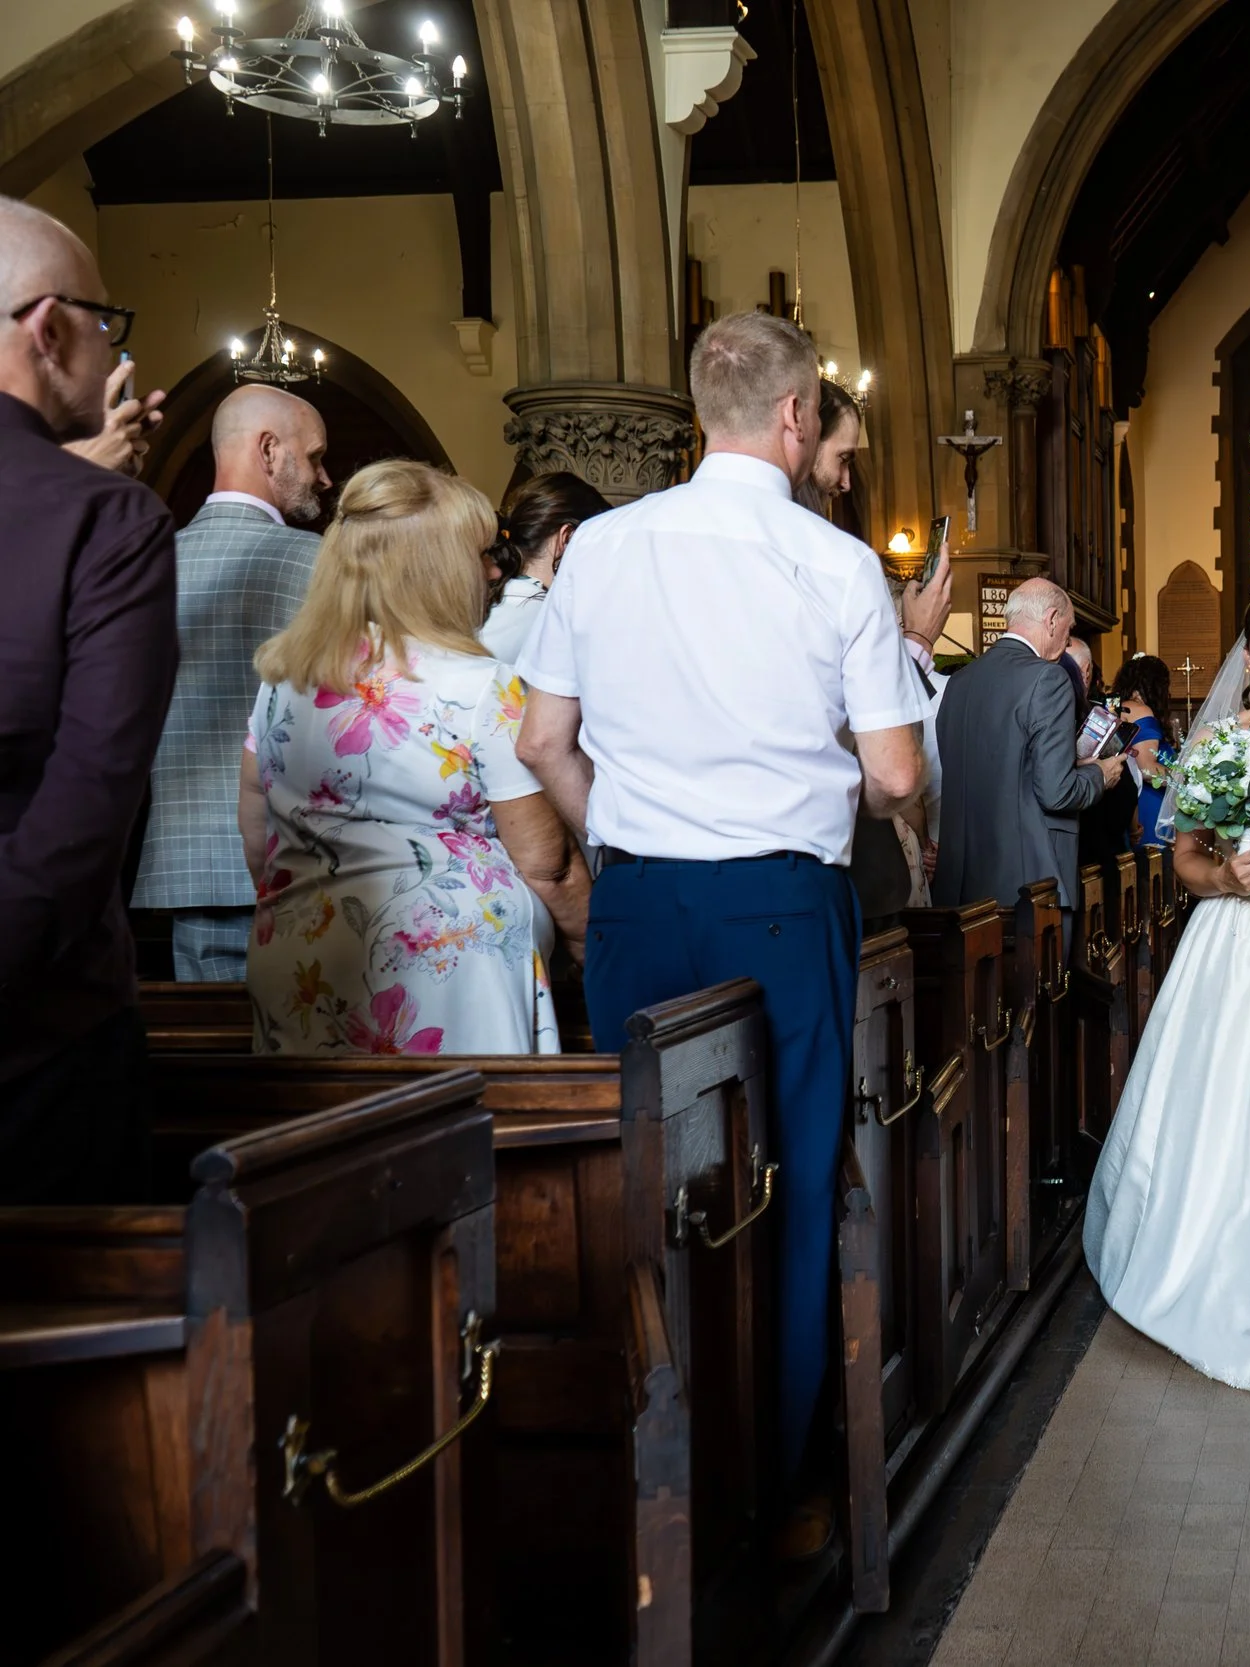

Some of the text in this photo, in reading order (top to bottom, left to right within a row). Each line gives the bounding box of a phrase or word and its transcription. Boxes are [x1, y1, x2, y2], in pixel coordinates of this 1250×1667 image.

[983, 589, 1006, 600] 186
[983, 603, 1005, 615] 237
[983, 632, 1004, 643] 30
